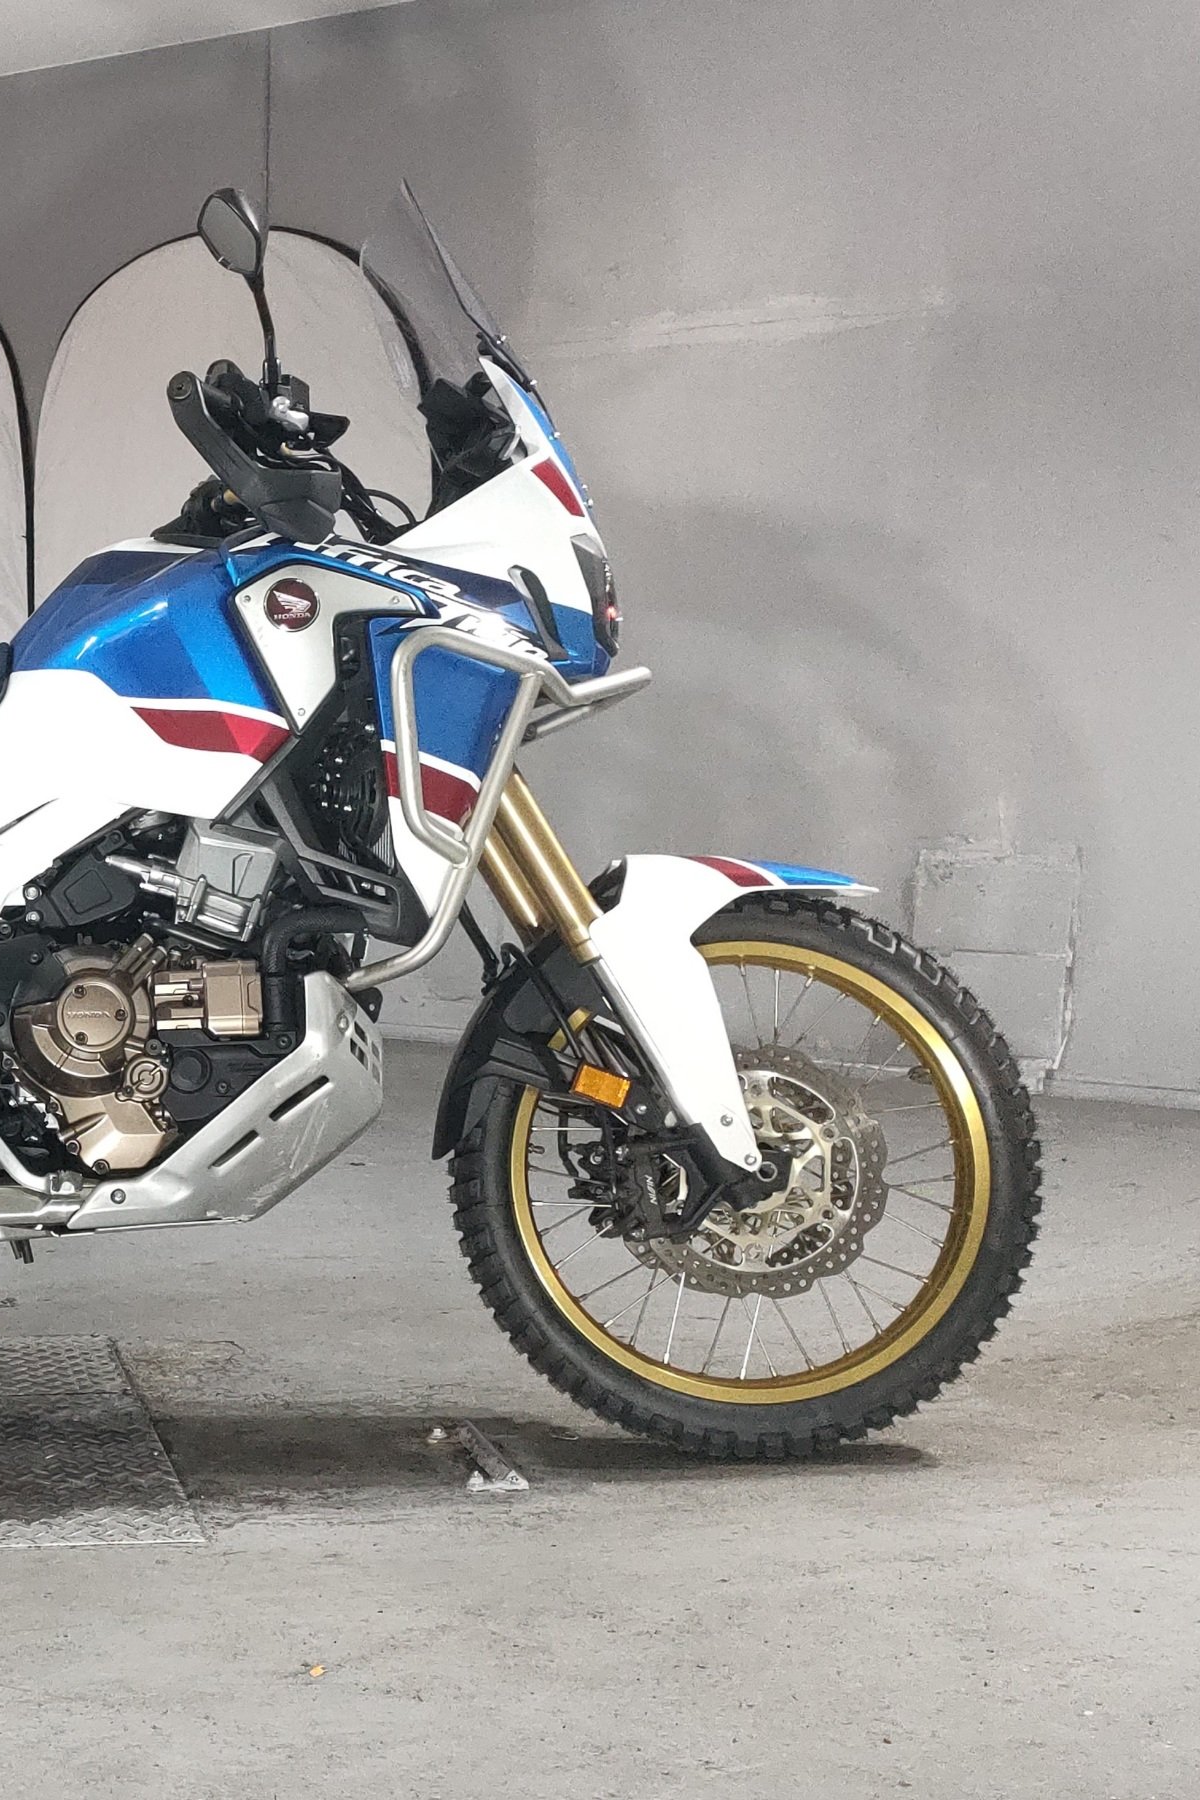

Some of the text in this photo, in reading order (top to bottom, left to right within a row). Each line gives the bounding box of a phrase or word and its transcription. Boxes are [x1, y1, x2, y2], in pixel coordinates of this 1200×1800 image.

[260, 532, 462, 598] frica
[273, 612, 312, 620] HONDA
[66, 1009, 112, 1019] HONDA
